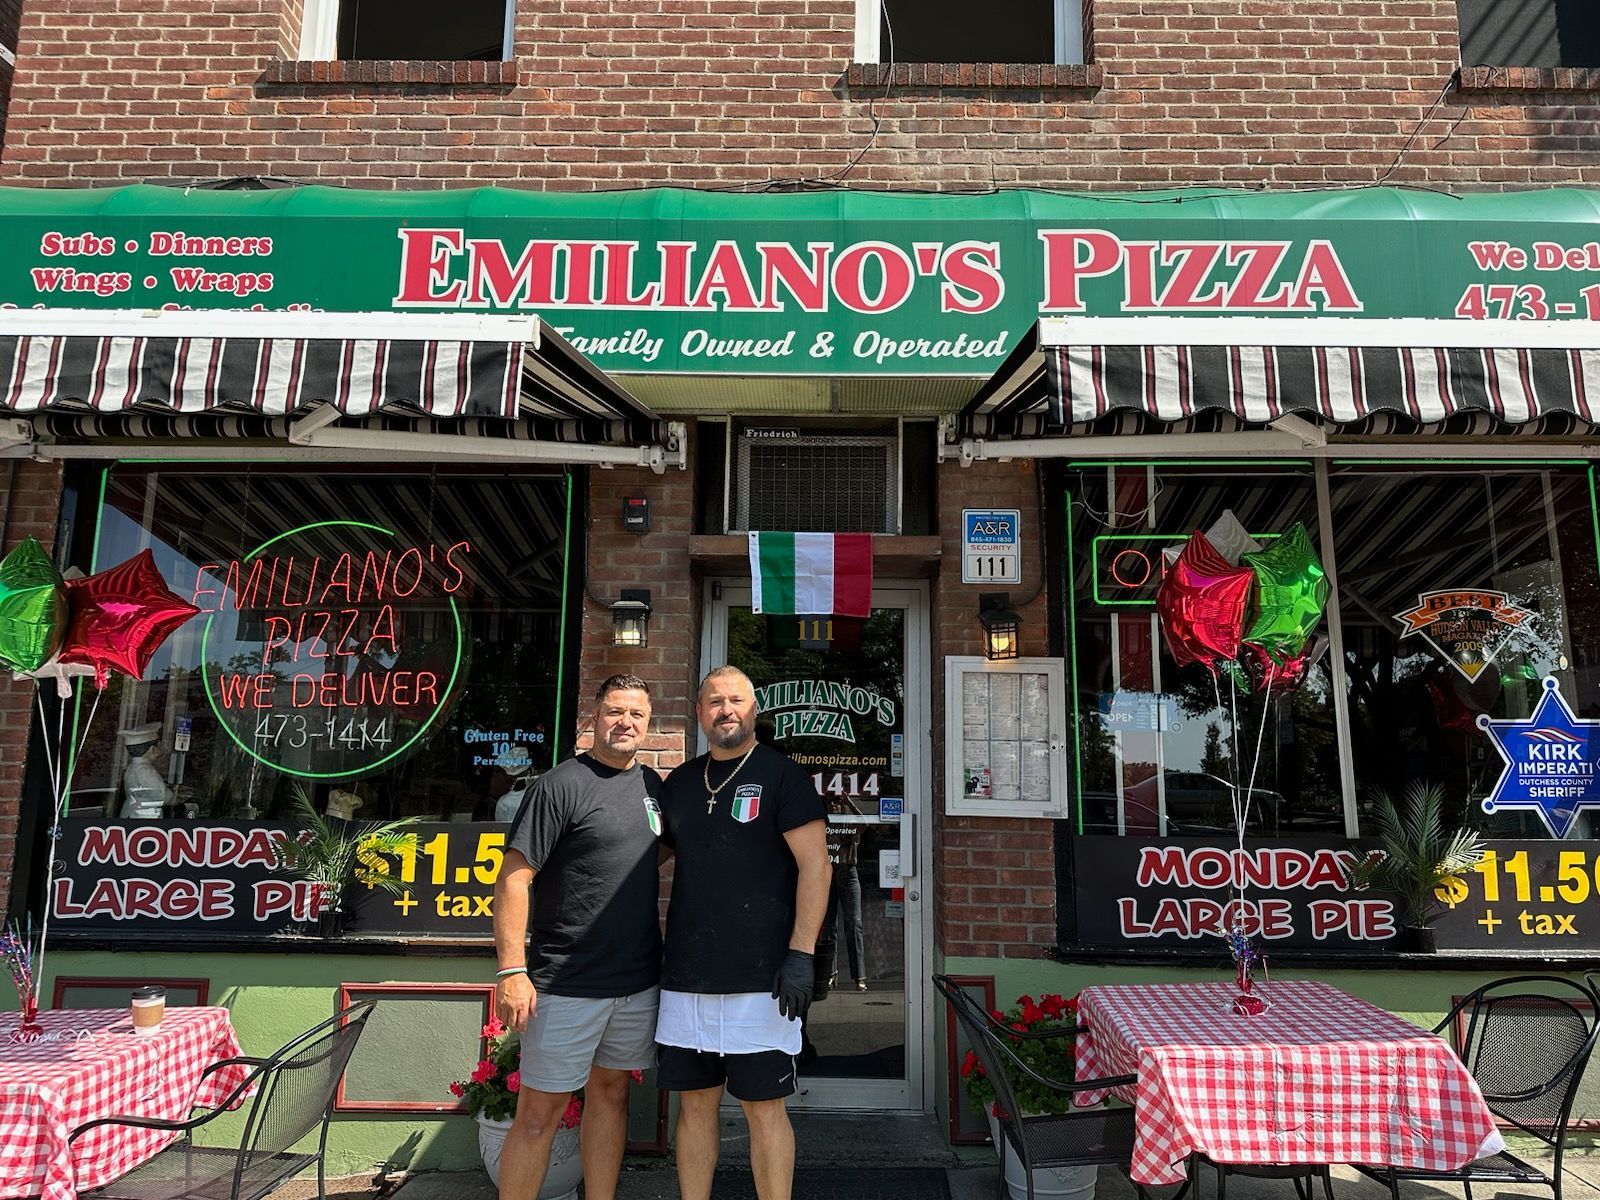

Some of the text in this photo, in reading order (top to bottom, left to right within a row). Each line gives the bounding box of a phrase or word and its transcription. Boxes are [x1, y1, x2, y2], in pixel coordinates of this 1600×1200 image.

[40, 231, 273, 256] Subs Dinners
[1467, 241, 1600, 271] We Del
[30, 268, 274, 297] Wings Wraps
[392, 228, 1364, 313] EMILIANO'S PIZZA
[681, 328, 795, 359] Owned
[809, 331, 835, 359] &
[853, 329, 1009, 364] Operated
[745, 428, 798, 438] Friedrich
[971, 521, 1010, 536] A&R
[192, 541, 470, 613] EMILIANO'S
[976, 557, 1005, 577] 111
[1429, 594, 1505, 611] BEST
[265, 605, 397, 666] PIZZA
[798, 620, 835, 641] 111
[220, 671, 438, 709] WE DELIVER
[774, 710, 856, 744] PIZZA
[1106, 713, 1134, 722] OPEN
[254, 713, 393, 751] 473-1414
[464, 728, 545, 743] Gluten Free
[788, 753, 887, 767] ilianospizza.com
[1528, 743, 1582, 761] KIRK
[1518, 762, 1593, 775] IMPERATI
[1518, 778, 1594, 786] DUTCHESS COUNTY
[1529, 787, 1585, 798] SHERIFF
[825, 827, 857, 835] Operated
[78, 825, 318, 869] MONDAY
[1136, 846, 1388, 891] MONDAY
[53, 878, 233, 920] LARGE
[394, 890, 418, 916] +
[434, 890, 495, 917] tax
[1117, 898, 1579, 941] LARGE PIE + tax
